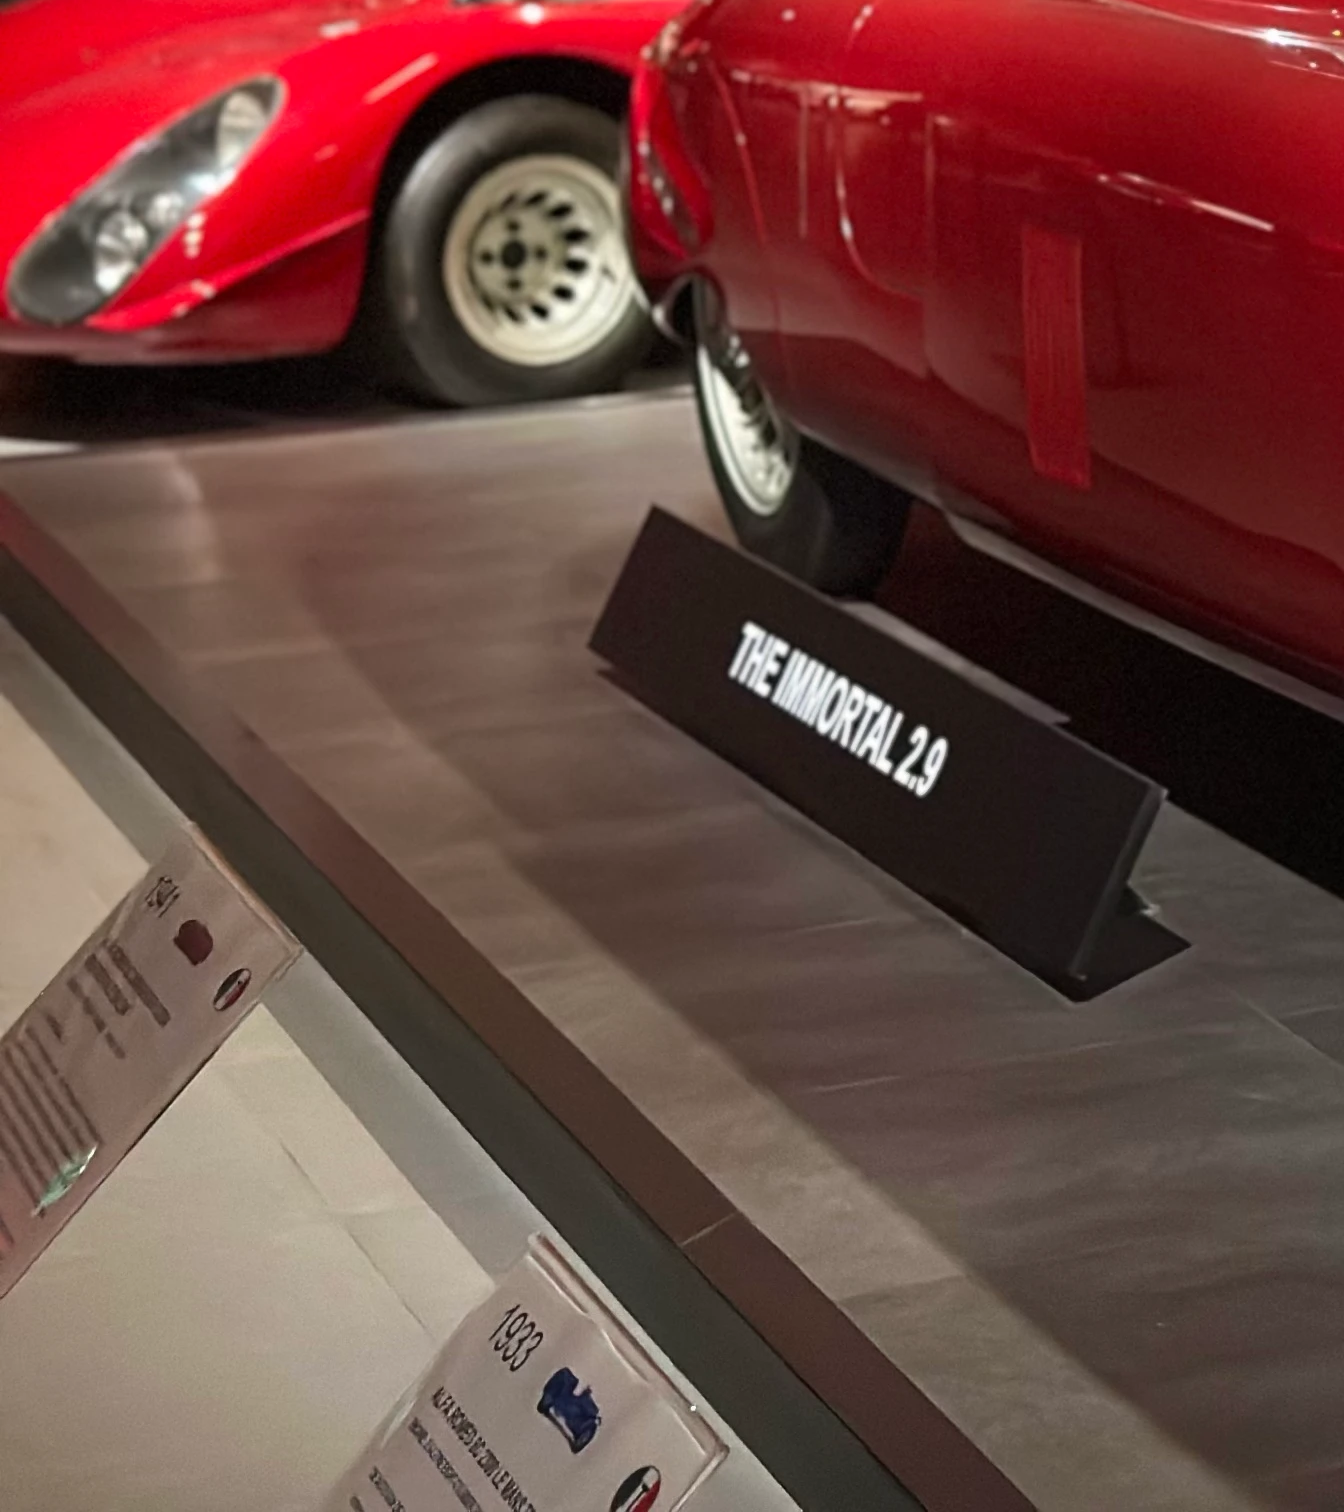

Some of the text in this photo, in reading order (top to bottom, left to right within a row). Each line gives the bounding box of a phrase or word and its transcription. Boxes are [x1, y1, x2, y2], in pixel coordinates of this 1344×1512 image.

[728, 620, 949, 798] THE IMMORTAL 2.9
[488, 1303, 544, 1372] 1933
